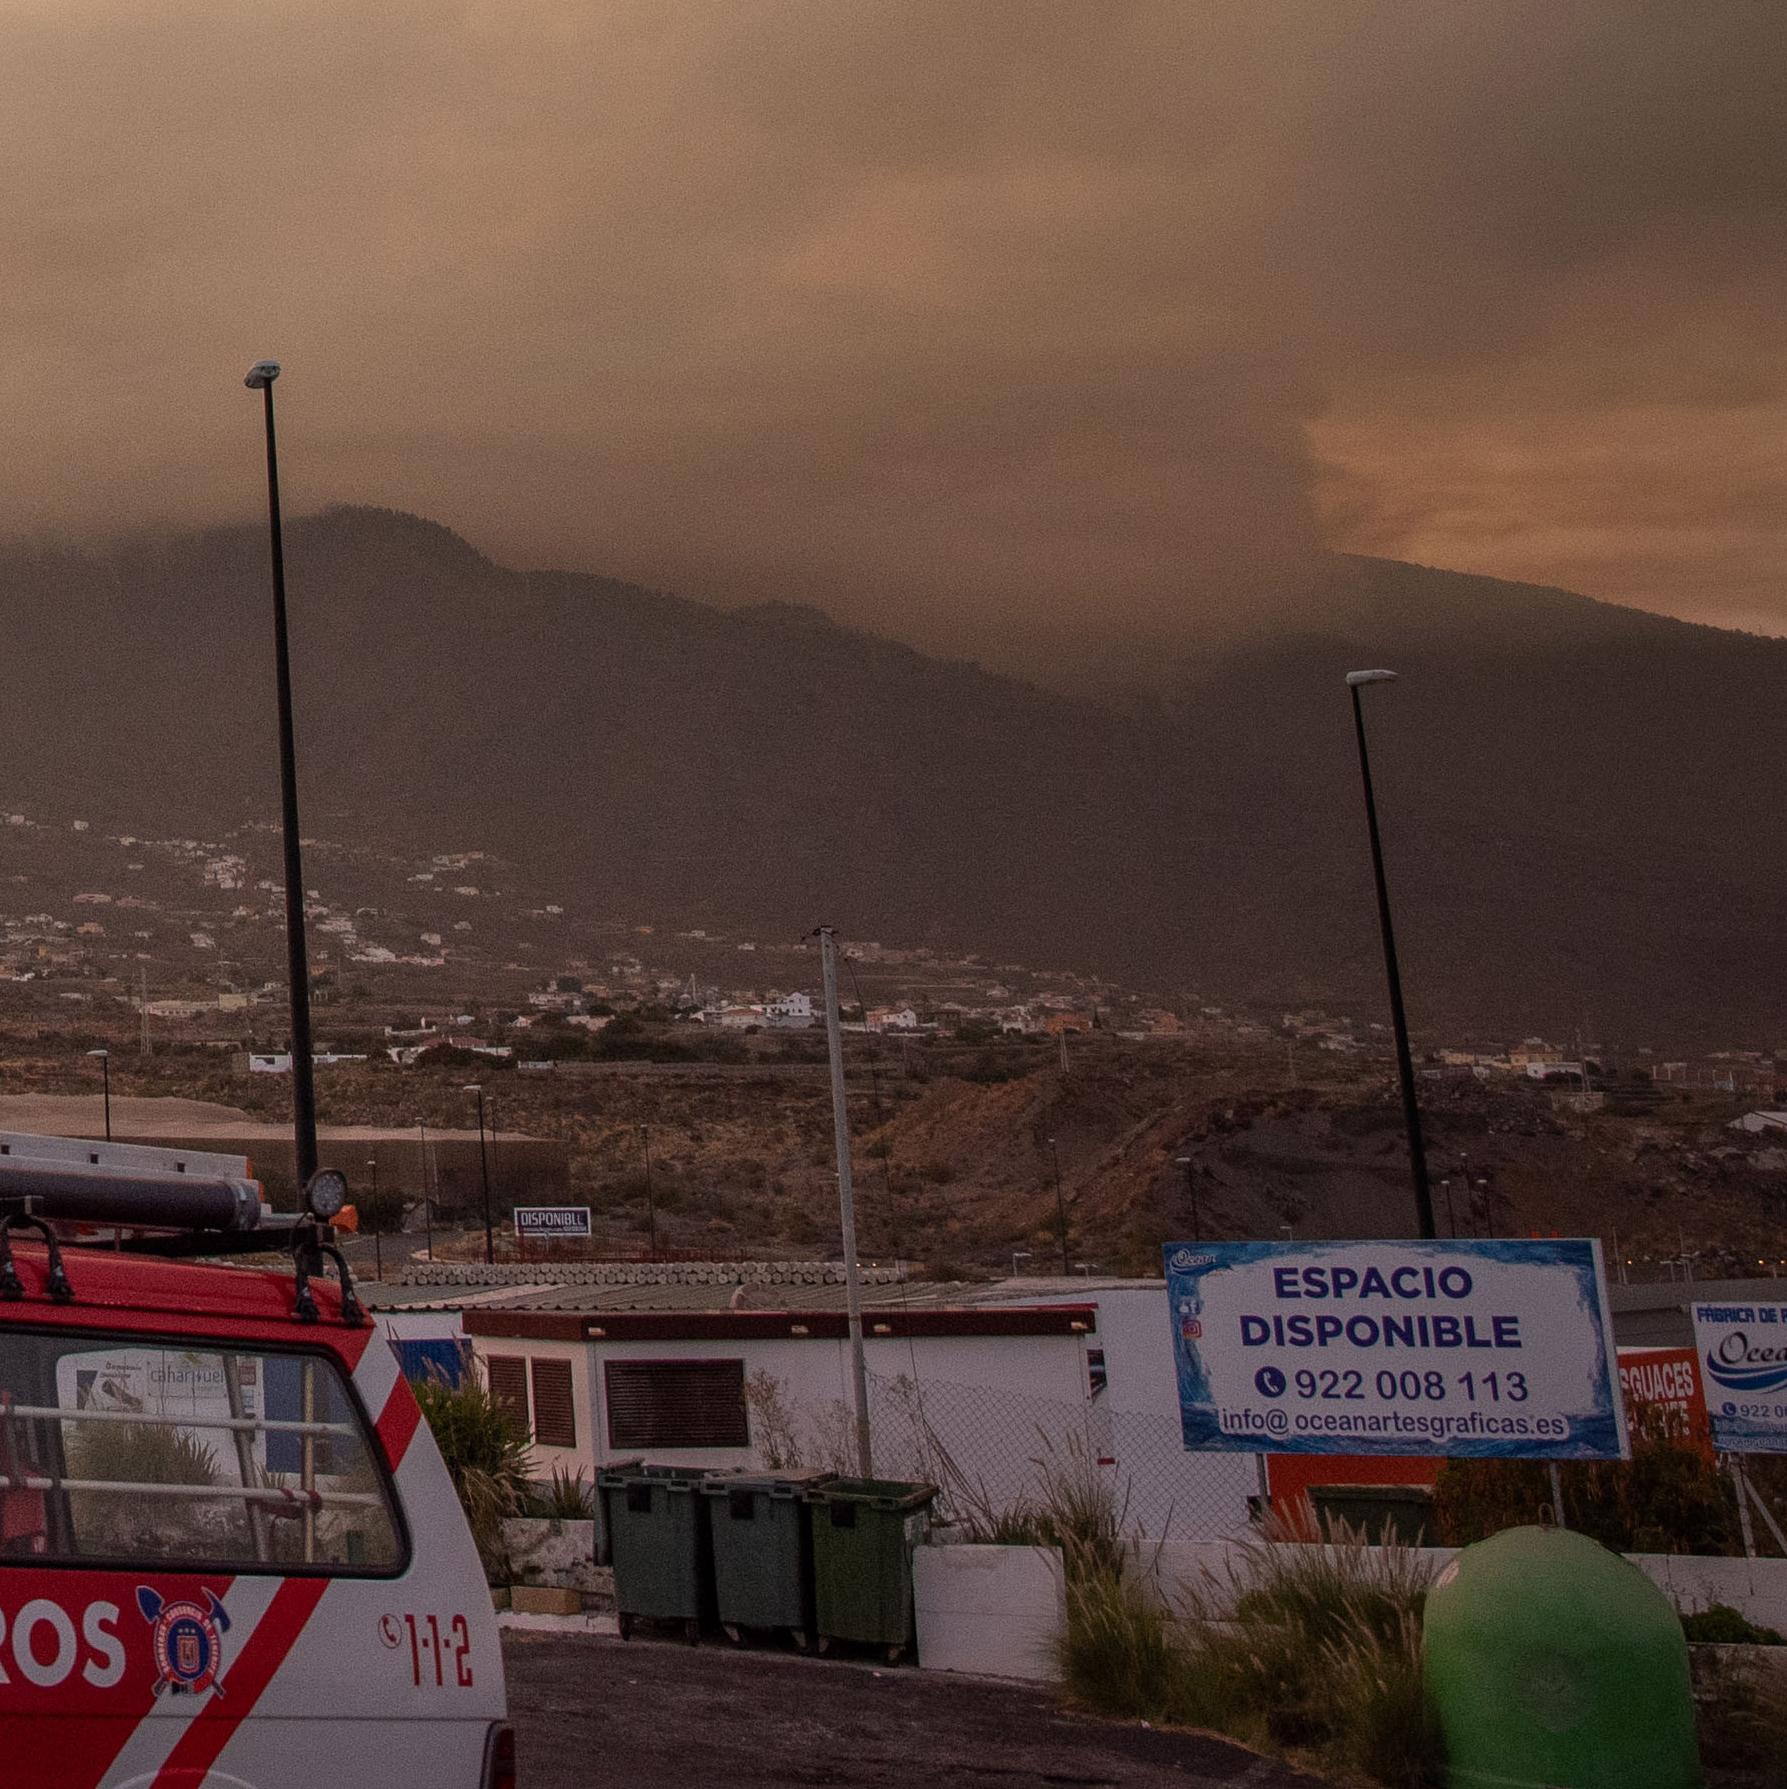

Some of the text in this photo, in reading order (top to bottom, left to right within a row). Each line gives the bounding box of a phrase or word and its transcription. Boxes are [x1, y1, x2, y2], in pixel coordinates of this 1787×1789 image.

[1272, 1266, 1474, 1300] ESPACIO
[1239, 1314, 1523, 1349] DISPONIBLE
[1294, 1369, 1529, 1403] 922 008 113
[1222, 1407, 1566, 1439] info@ oceanartesgraficas.es
[1739, 1404, 1771, 1418] 922
